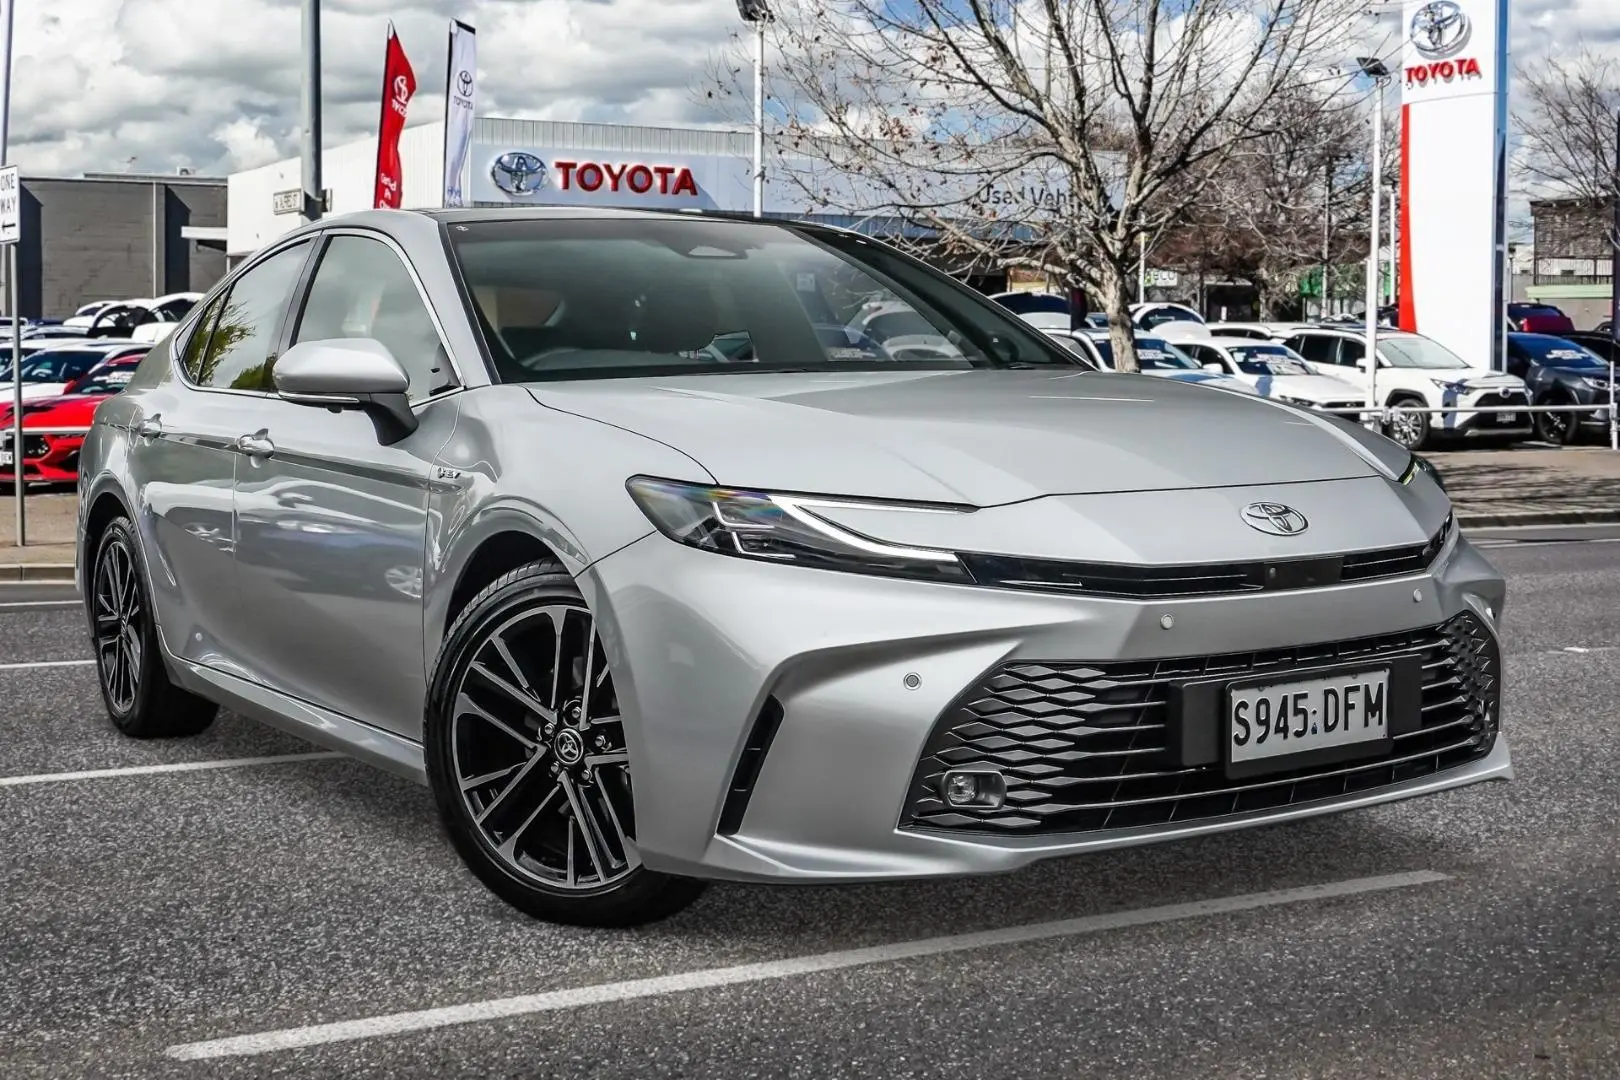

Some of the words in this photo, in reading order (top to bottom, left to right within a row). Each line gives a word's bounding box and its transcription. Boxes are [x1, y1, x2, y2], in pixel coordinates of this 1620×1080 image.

[1405, 58, 1481, 83] TOYOTA
[0, 173, 15, 192] ONE
[555, 161, 698, 196] TOYOTA
[0, 196, 17, 215] WAY
